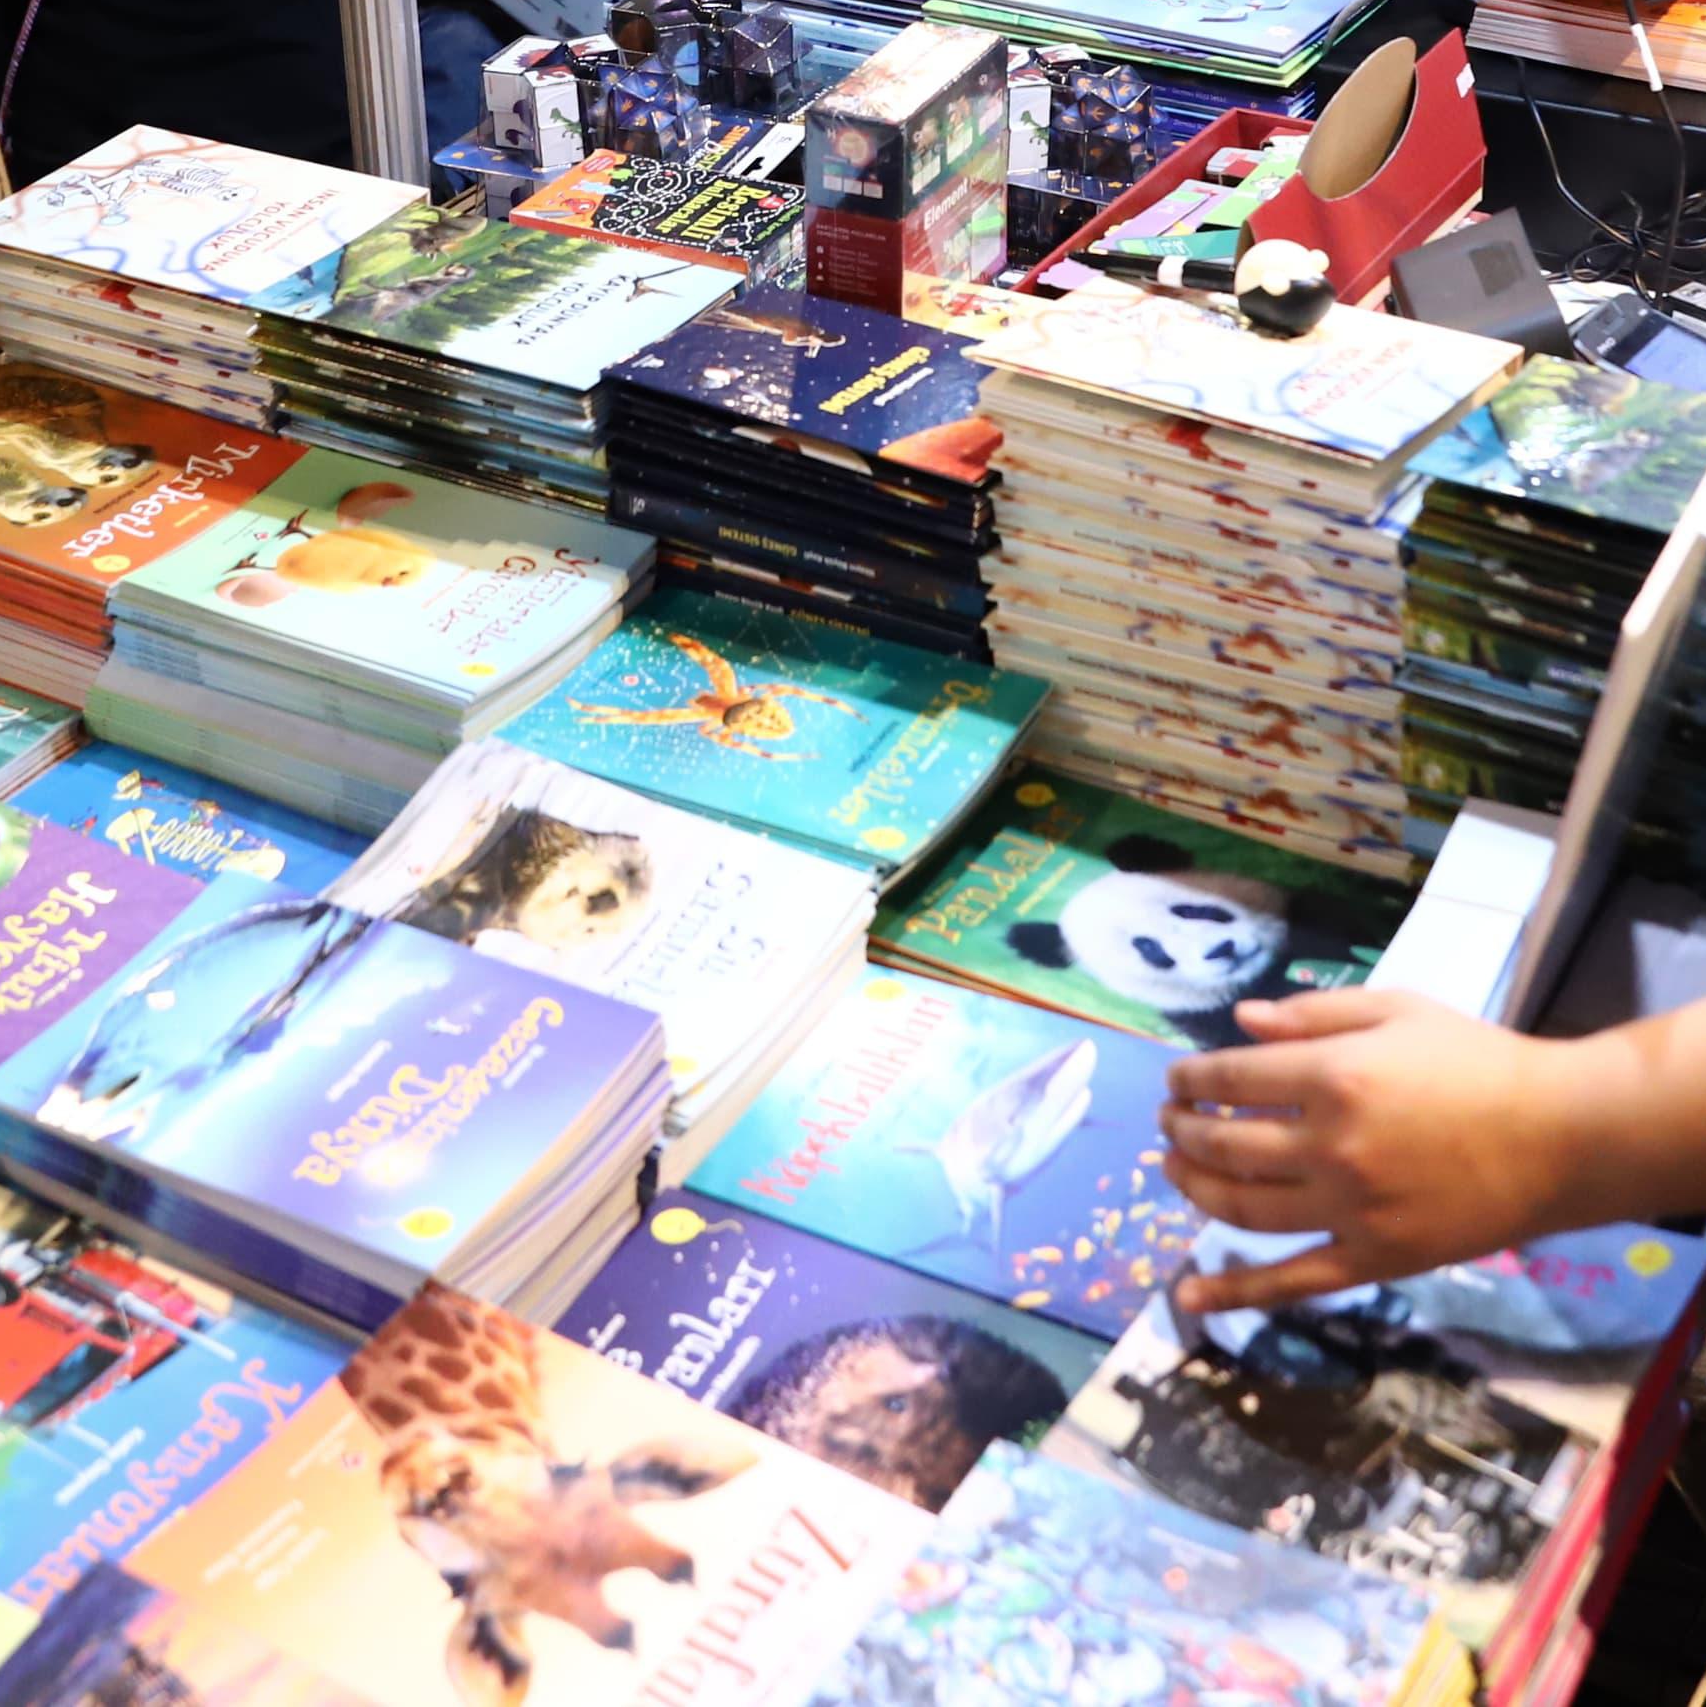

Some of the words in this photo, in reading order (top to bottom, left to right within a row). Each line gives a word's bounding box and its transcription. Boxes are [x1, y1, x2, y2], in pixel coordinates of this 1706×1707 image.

[923, 183, 971, 232] Element
[61, 441, 261, 560] Mirketler
[904, 807, 1085, 946] Pandalar
[293, 1063, 455, 1186] Dünya
